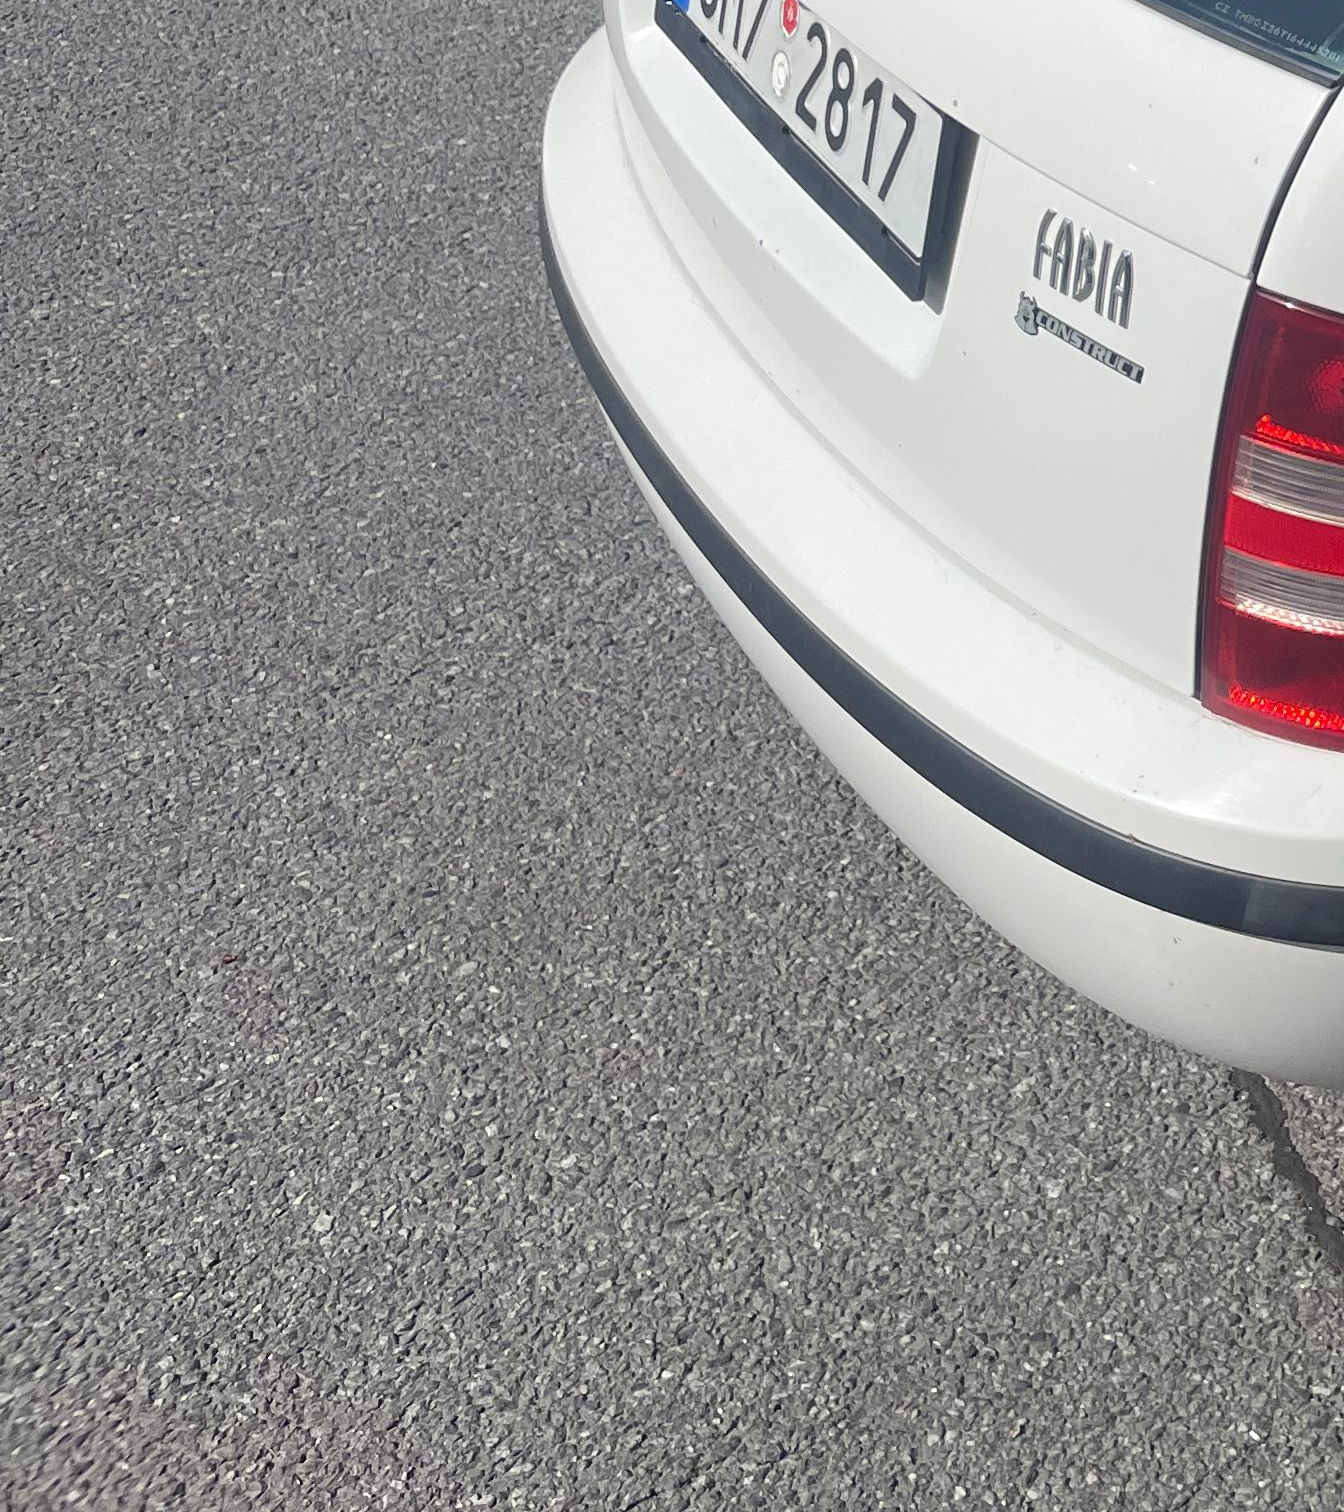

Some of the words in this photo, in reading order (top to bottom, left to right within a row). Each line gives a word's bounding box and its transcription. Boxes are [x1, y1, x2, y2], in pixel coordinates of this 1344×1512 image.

[795, 22, 917, 202] 2817
[1033, 207, 1135, 329] FABIA
[1035, 309, 1143, 382] CONSTRUCT
